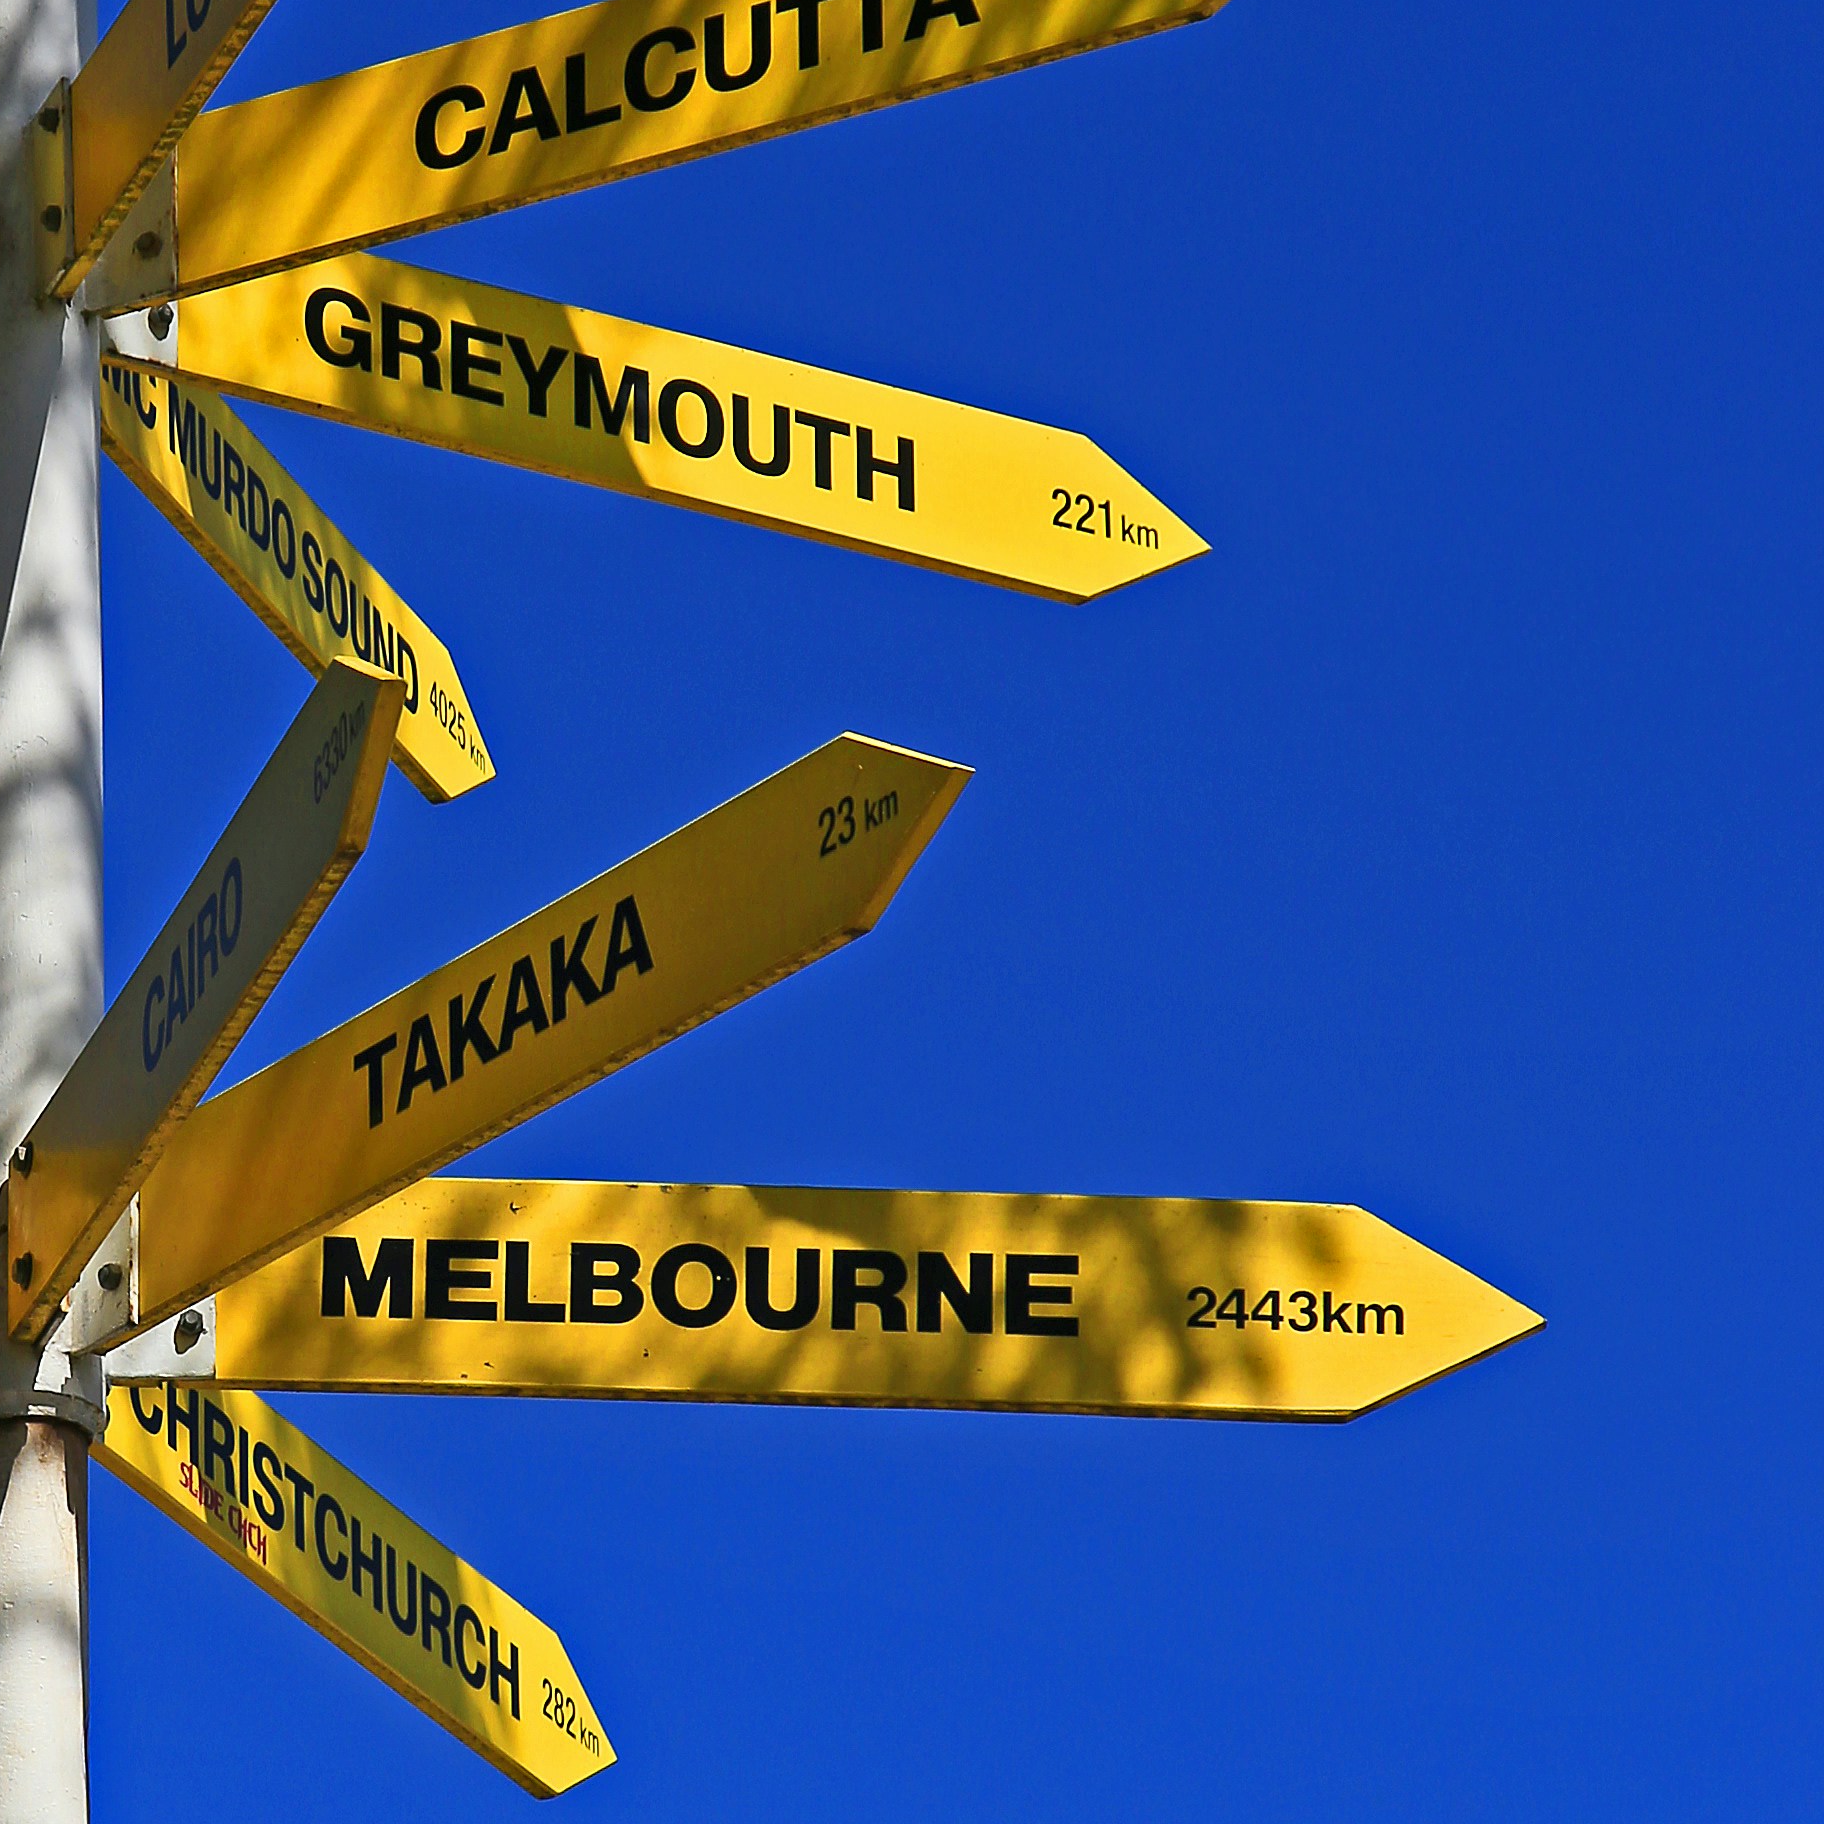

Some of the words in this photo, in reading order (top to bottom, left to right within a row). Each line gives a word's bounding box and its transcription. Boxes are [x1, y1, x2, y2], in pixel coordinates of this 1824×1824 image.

[304, 288, 915, 513] GREYMOUTH
[168, 379, 296, 580] MURDO
[302, 529, 418, 715] SOUND
[430, 681, 466, 750] 4025
[141, 856, 243, 1073] CAIRO
[354, 895, 653, 1129] TAKAKA
[817, 796, 856, 859] 23
[864, 788, 899, 834] km
[320, 1235, 1079, 1337] MELBOURNE
[1185, 1284, 1405, 1338] 2443km
